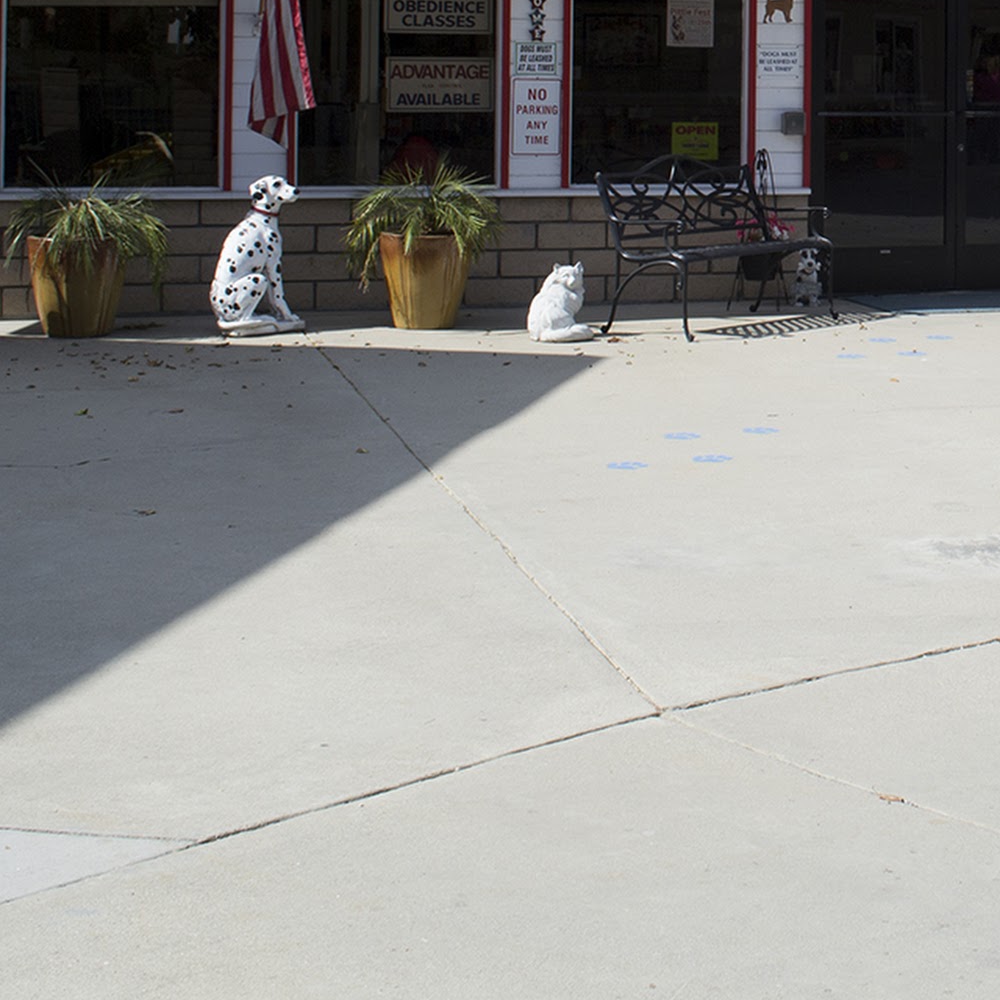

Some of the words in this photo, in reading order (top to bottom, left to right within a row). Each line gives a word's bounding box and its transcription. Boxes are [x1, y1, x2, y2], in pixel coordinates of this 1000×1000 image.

[393, 0, 485, 14] OBEDIENCE
[402, 14, 476, 28] CLASSES
[520, 45, 535, 53] DOGS
[536, 45, 552, 53] MUST
[519, 54, 527, 62] BE
[528, 54, 553, 62] LEASHED
[390, 64, 490, 79] ADVANTAGE
[396, 93, 481, 106] AVAILABLE
[528, 89, 547, 101] NO
[516, 105, 558, 115] PARKING
[526, 121, 548, 130] ANY
[675, 125, 716, 135] OPEN
[525, 136, 549, 145] TIME
